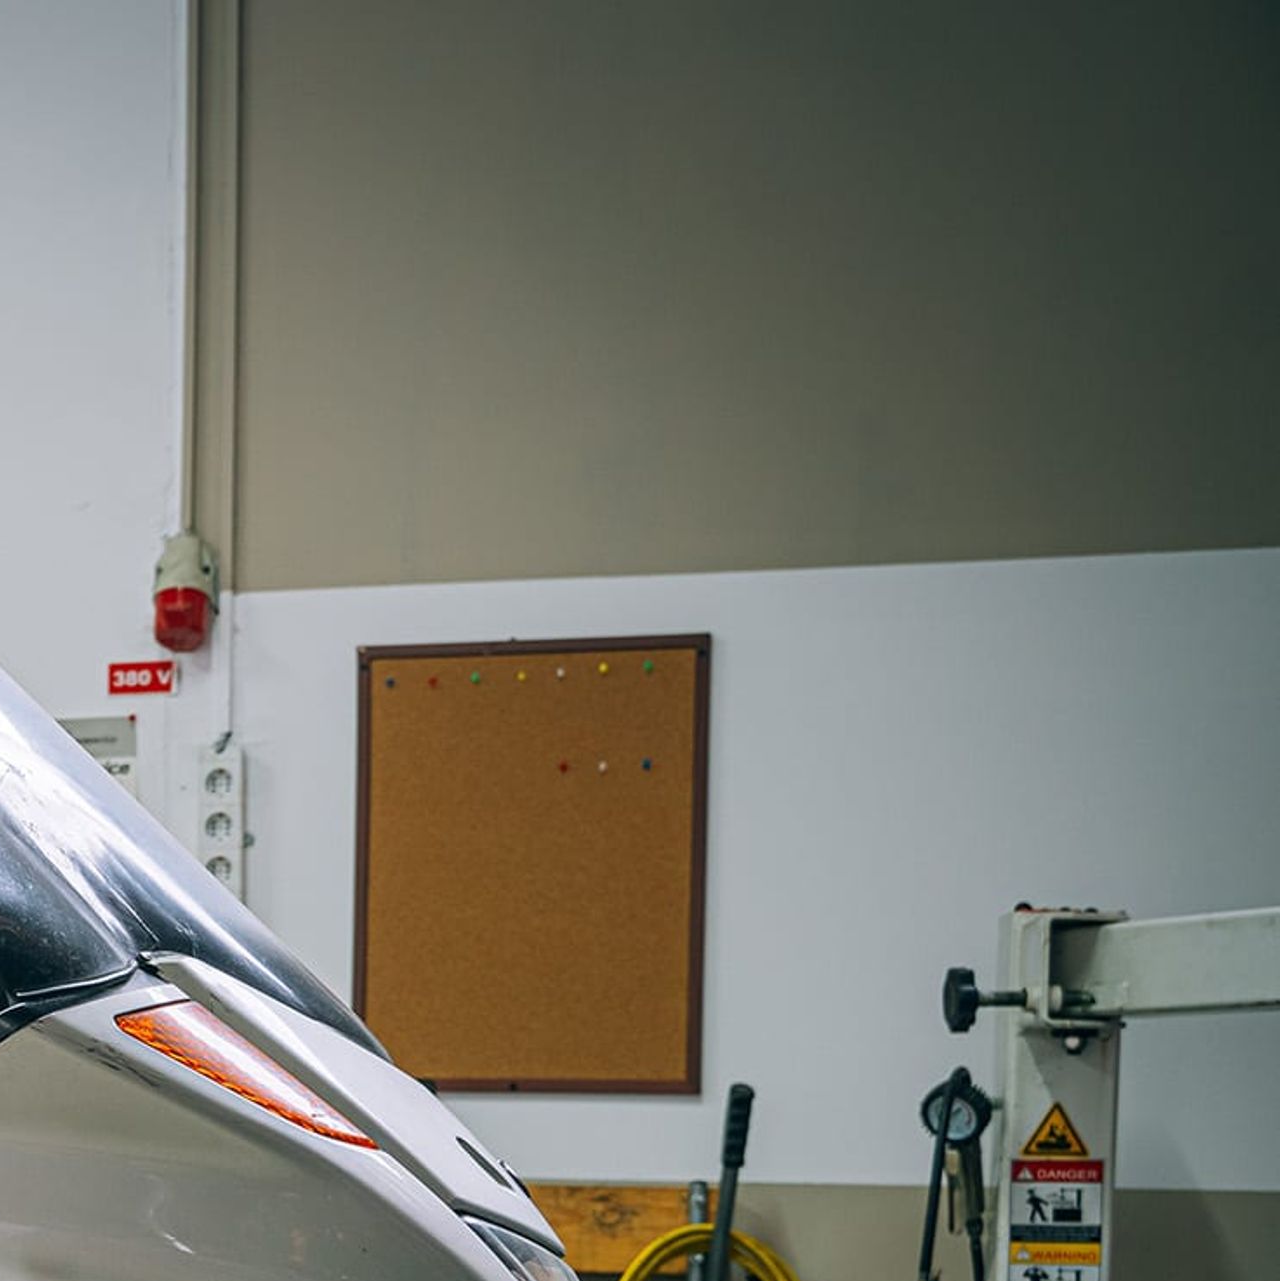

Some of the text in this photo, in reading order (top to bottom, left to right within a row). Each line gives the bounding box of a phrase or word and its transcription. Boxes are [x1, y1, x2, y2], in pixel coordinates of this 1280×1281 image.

[112, 669, 172, 687] 380 V
[1037, 1169, 1098, 1179] DANGER
[1033, 1250, 1097, 1261] WARNING
